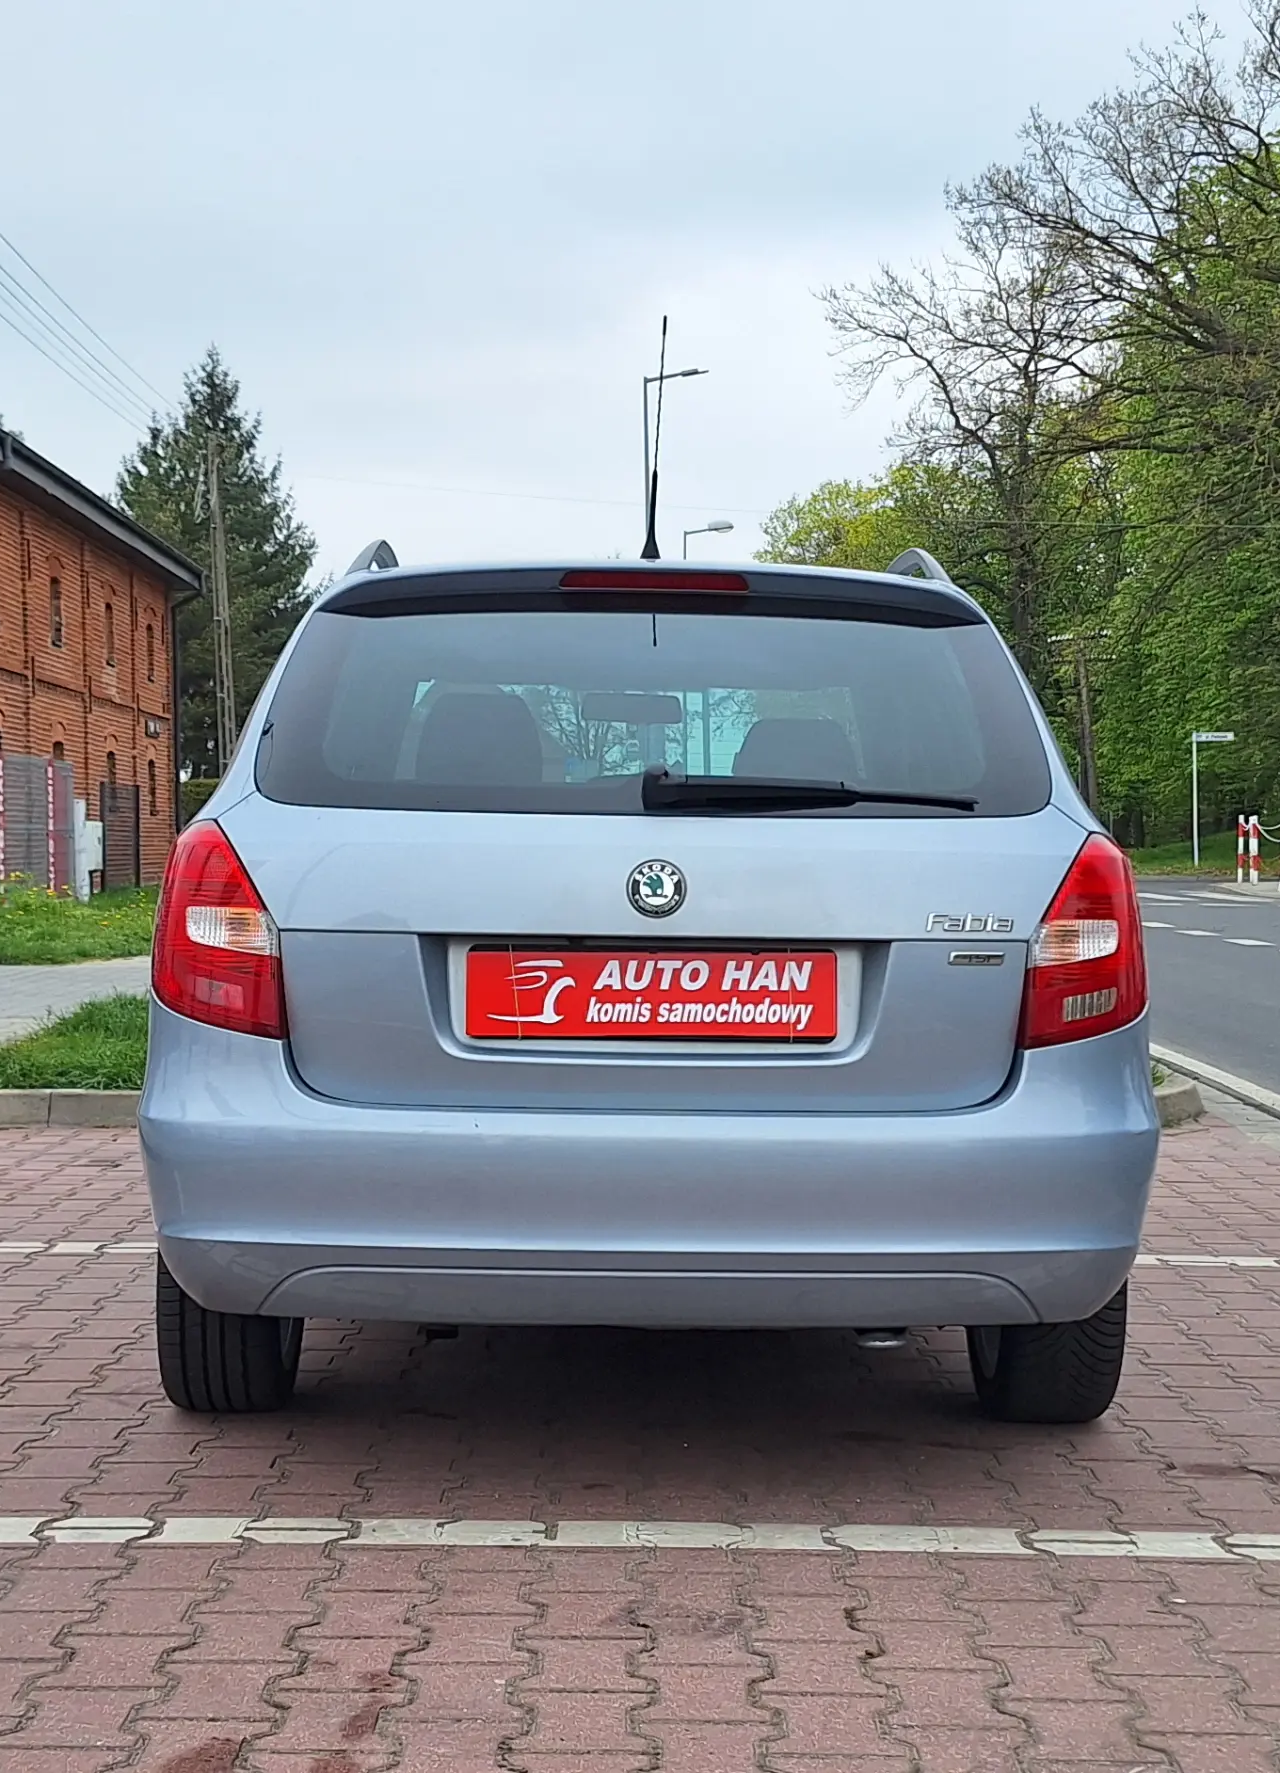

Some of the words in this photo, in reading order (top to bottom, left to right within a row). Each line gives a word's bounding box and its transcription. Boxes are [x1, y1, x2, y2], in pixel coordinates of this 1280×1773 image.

[926, 912, 1014, 933] Fabia
[968, 955, 991, 964] TSI
[593, 959, 710, 992] AUTO
[721, 960, 813, 992] HAN
[585, 996, 652, 1024] komis
[656, 997, 814, 1031] samochodowy
